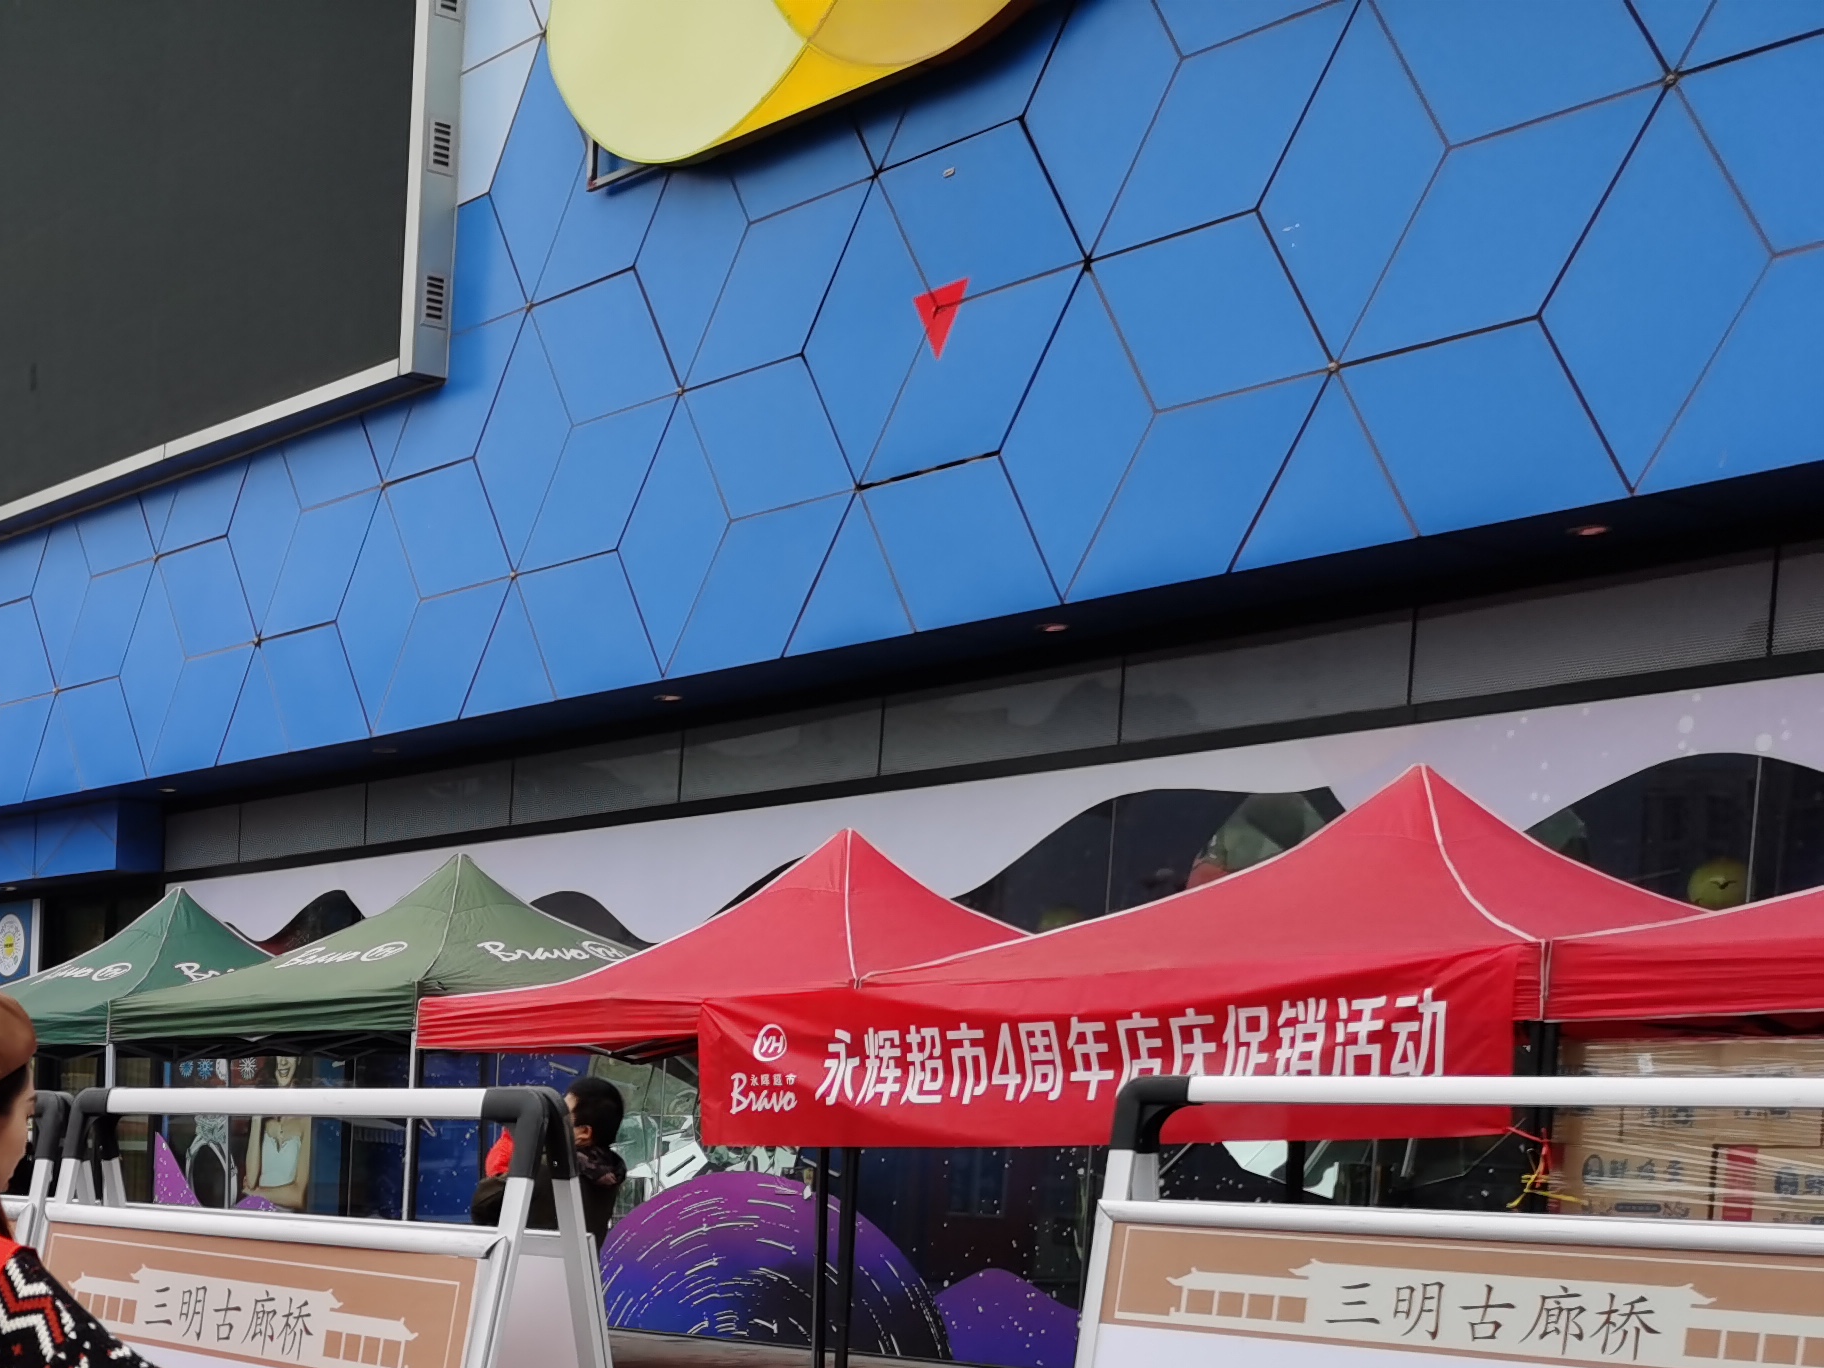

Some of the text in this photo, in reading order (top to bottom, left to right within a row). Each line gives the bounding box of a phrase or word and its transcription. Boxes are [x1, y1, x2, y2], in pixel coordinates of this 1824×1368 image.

[477, 940, 590, 963] Bravo
[814, 988, 1448, 1107] 永辉超市4周年店庆促销活动
[729, 1071, 798, 1115] Bravo
[749, 1073, 798, 1087] 永辉超市
[144, 1285, 314, 1361] 三明古廊桥
[1324, 1281, 1662, 1362] 三明古廊桥
